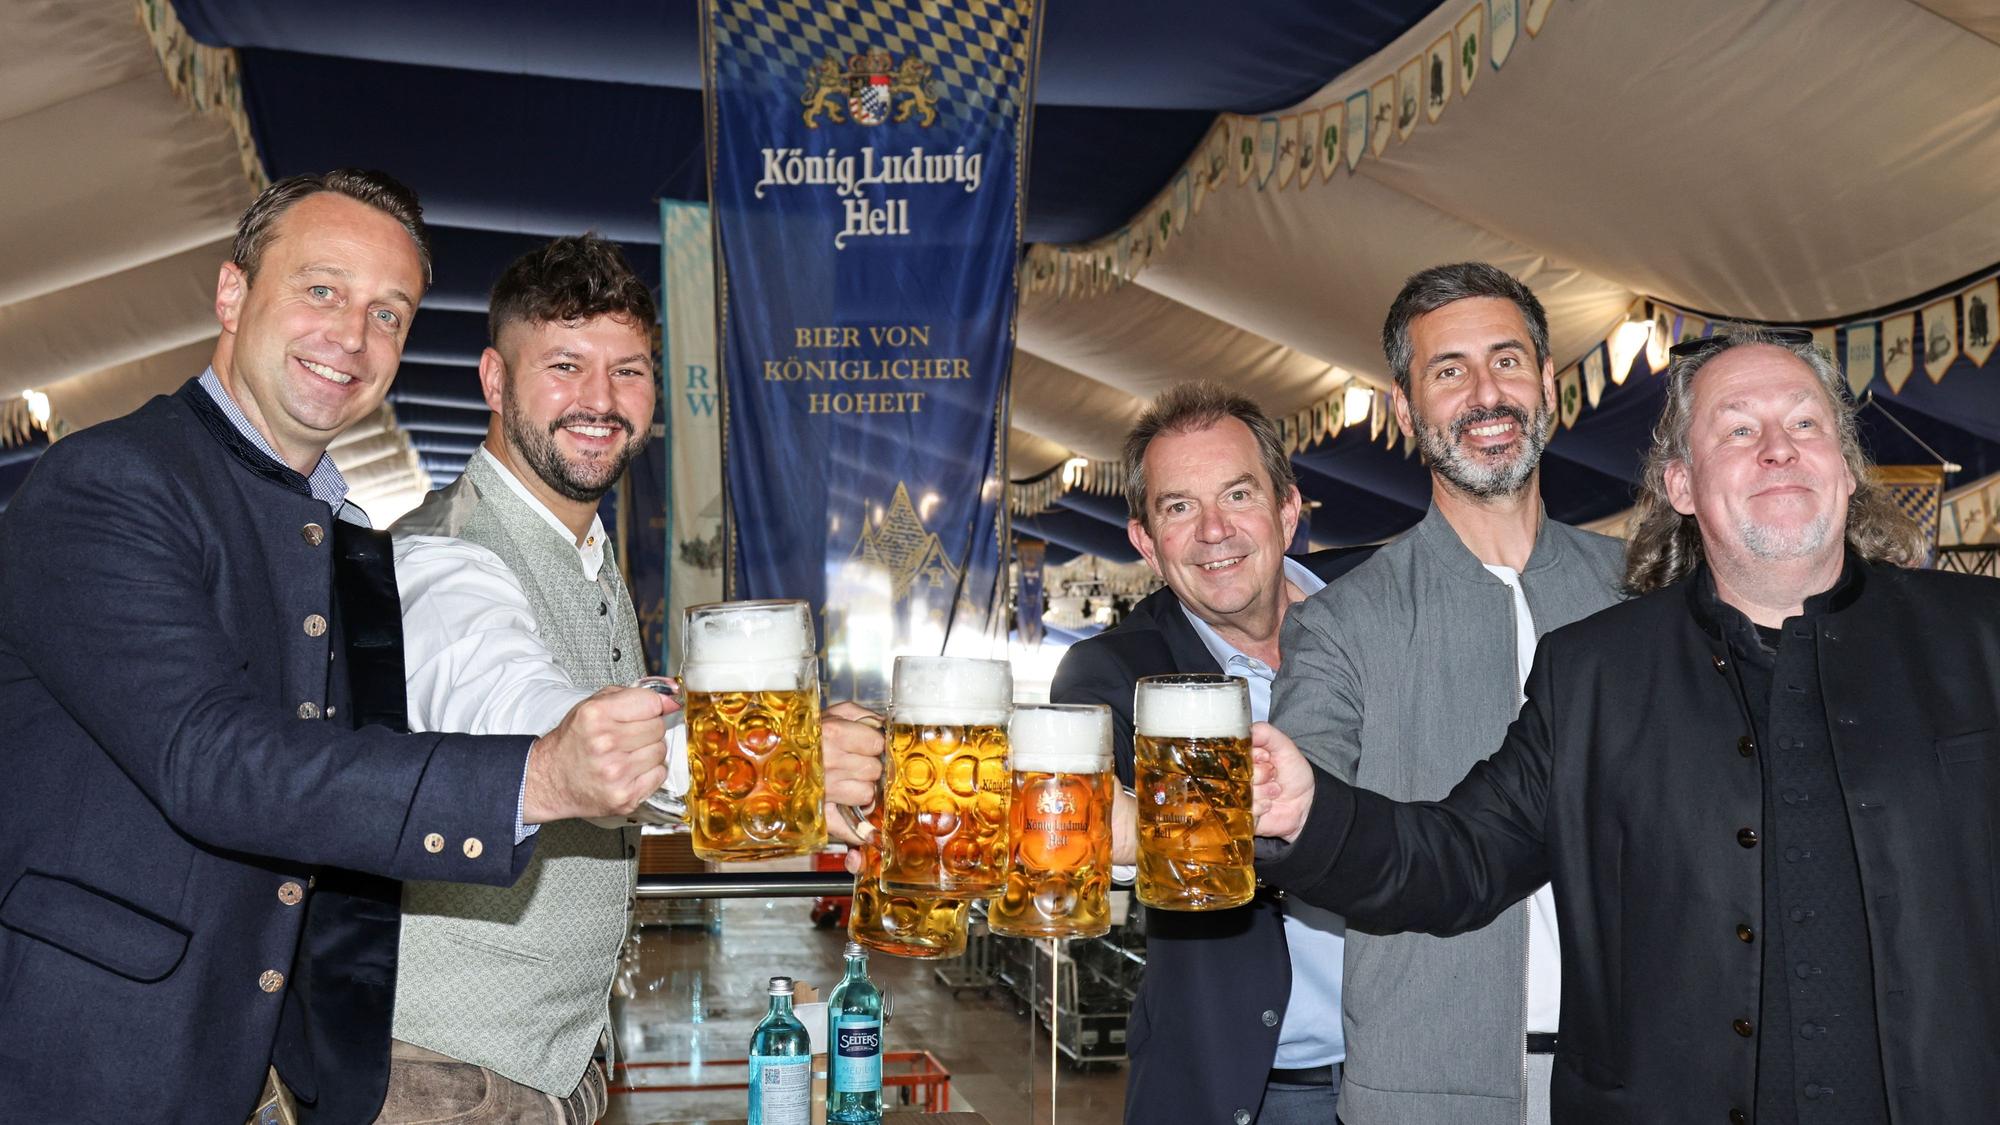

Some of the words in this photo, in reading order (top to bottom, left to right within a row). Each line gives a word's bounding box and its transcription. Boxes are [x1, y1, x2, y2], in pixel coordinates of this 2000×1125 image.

[755, 147, 855, 199] König
[854, 146, 982, 198] Ludwig
[835, 200, 910, 250] Hell
[794, 327, 861, 348] BIER
[870, 326, 930, 347] VON
[686, 364, 717, 389] R
[764, 356, 971, 381] KÖNIGLICHER
[808, 393, 925, 414] HOHEIT
[840, 1033, 879, 1048] SELTERS
